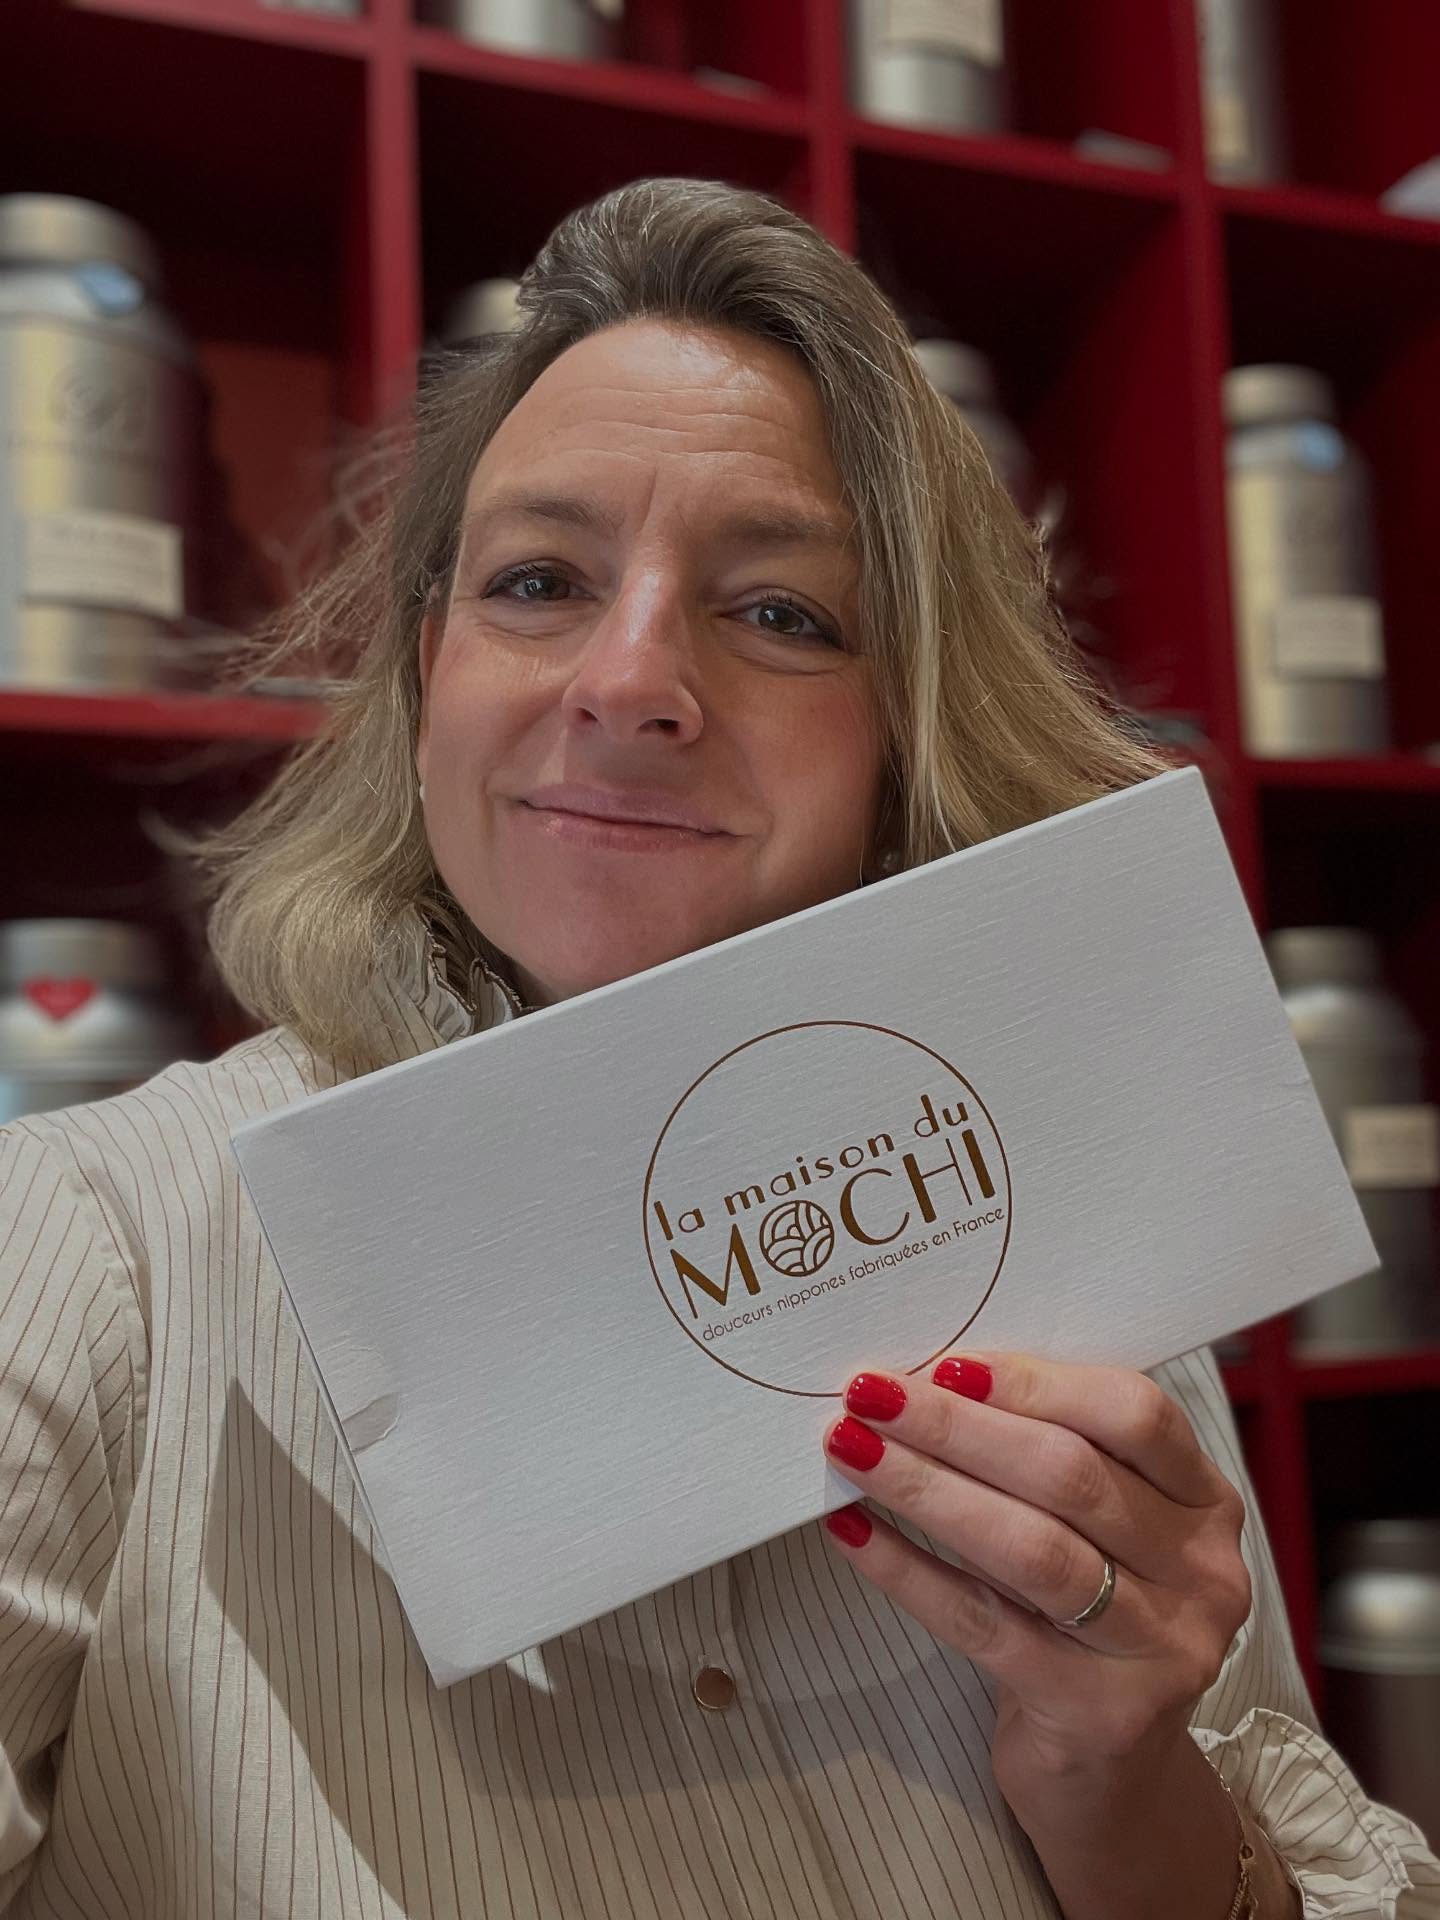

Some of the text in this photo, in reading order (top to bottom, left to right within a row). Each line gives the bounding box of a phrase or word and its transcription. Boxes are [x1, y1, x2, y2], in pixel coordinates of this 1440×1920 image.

[654, 1094, 969, 1241] la maison du
[669, 1129, 996, 1320] MOCHI
[702, 1207, 1006, 1342] douceurs nippones fabriquées en France
